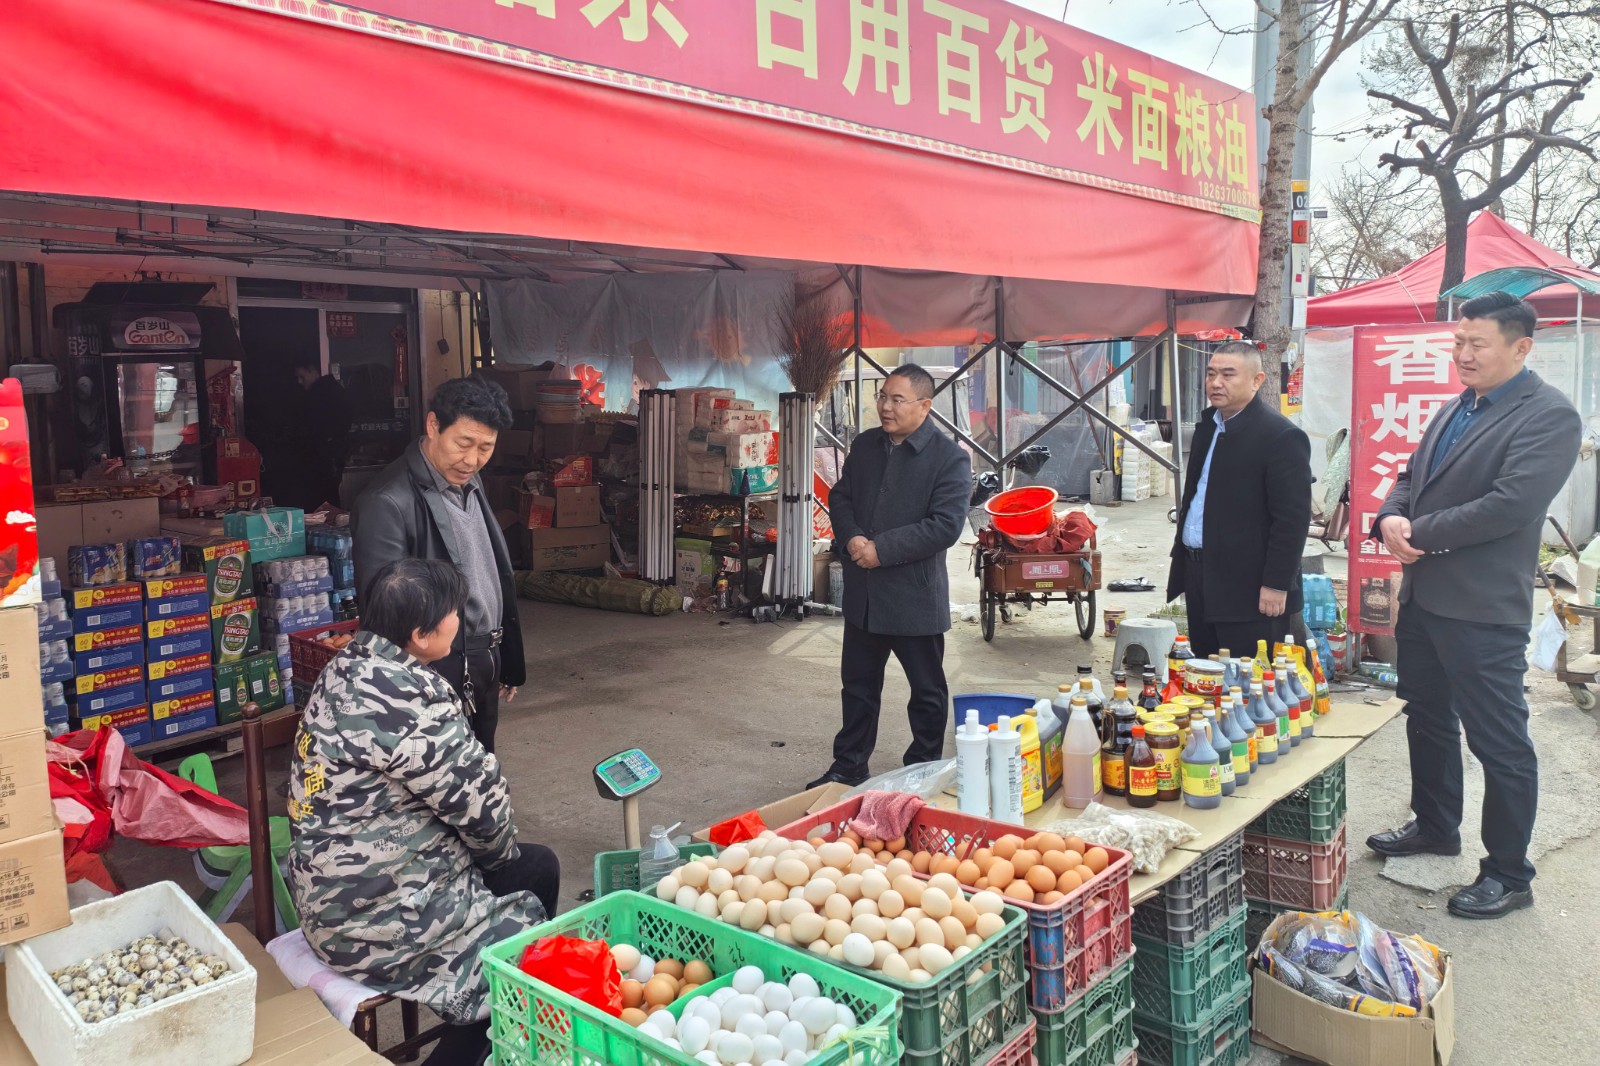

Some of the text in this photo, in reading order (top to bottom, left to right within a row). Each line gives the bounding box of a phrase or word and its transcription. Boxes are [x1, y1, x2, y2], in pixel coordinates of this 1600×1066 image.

[756, 0, 1249, 189] 日用百货 米面粮油
[136, 321, 170, 331] 百岁山
[217, 569, 243, 579] TSINGTAO
[224, 627, 250, 636] TSINGTAO
